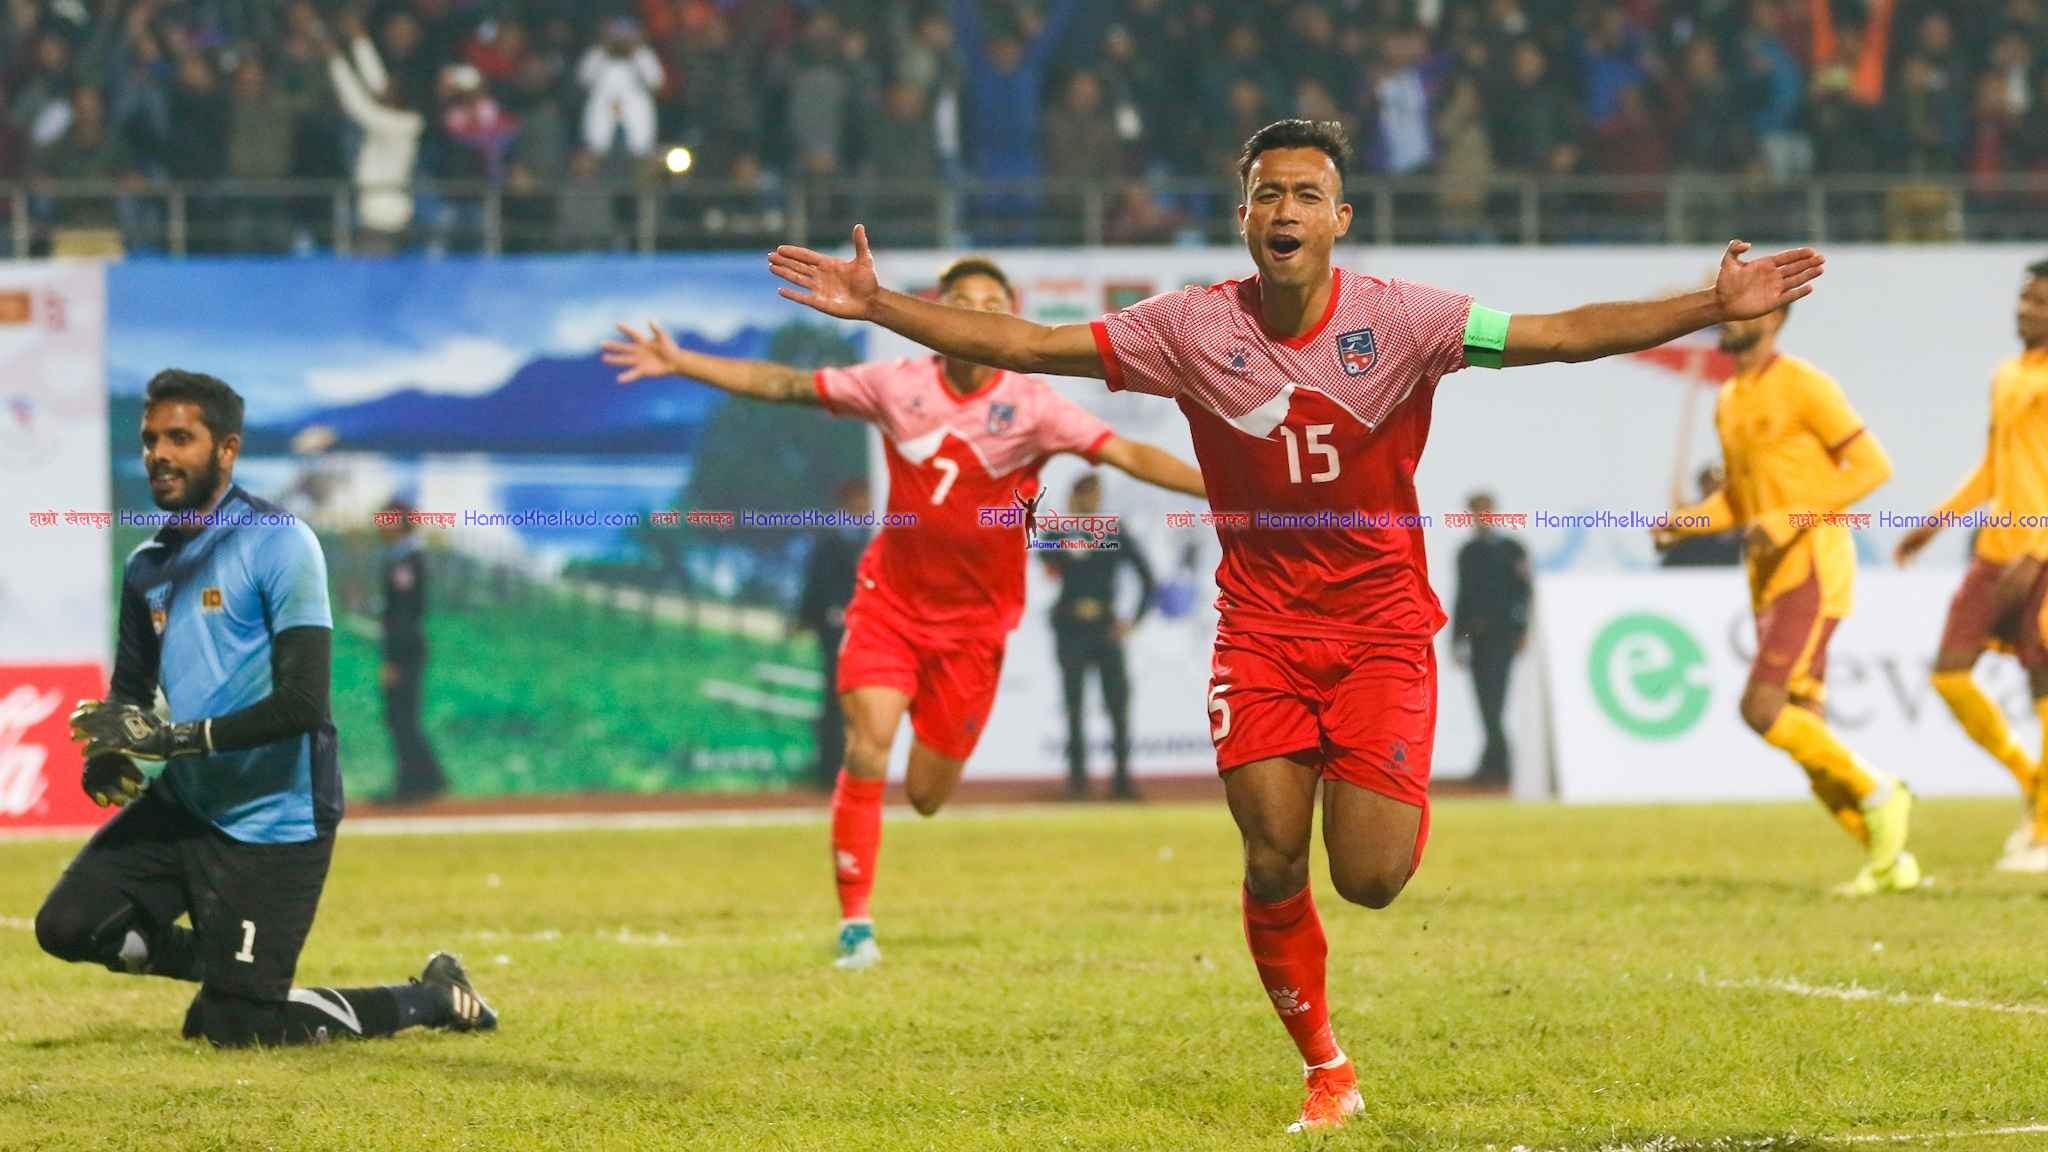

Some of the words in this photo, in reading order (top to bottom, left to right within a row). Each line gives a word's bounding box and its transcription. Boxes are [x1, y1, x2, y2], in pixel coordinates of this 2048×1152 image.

[1280, 423, 1341, 484] 15
[931, 457, 960, 505] 7
[235, 919, 257, 963] 1
